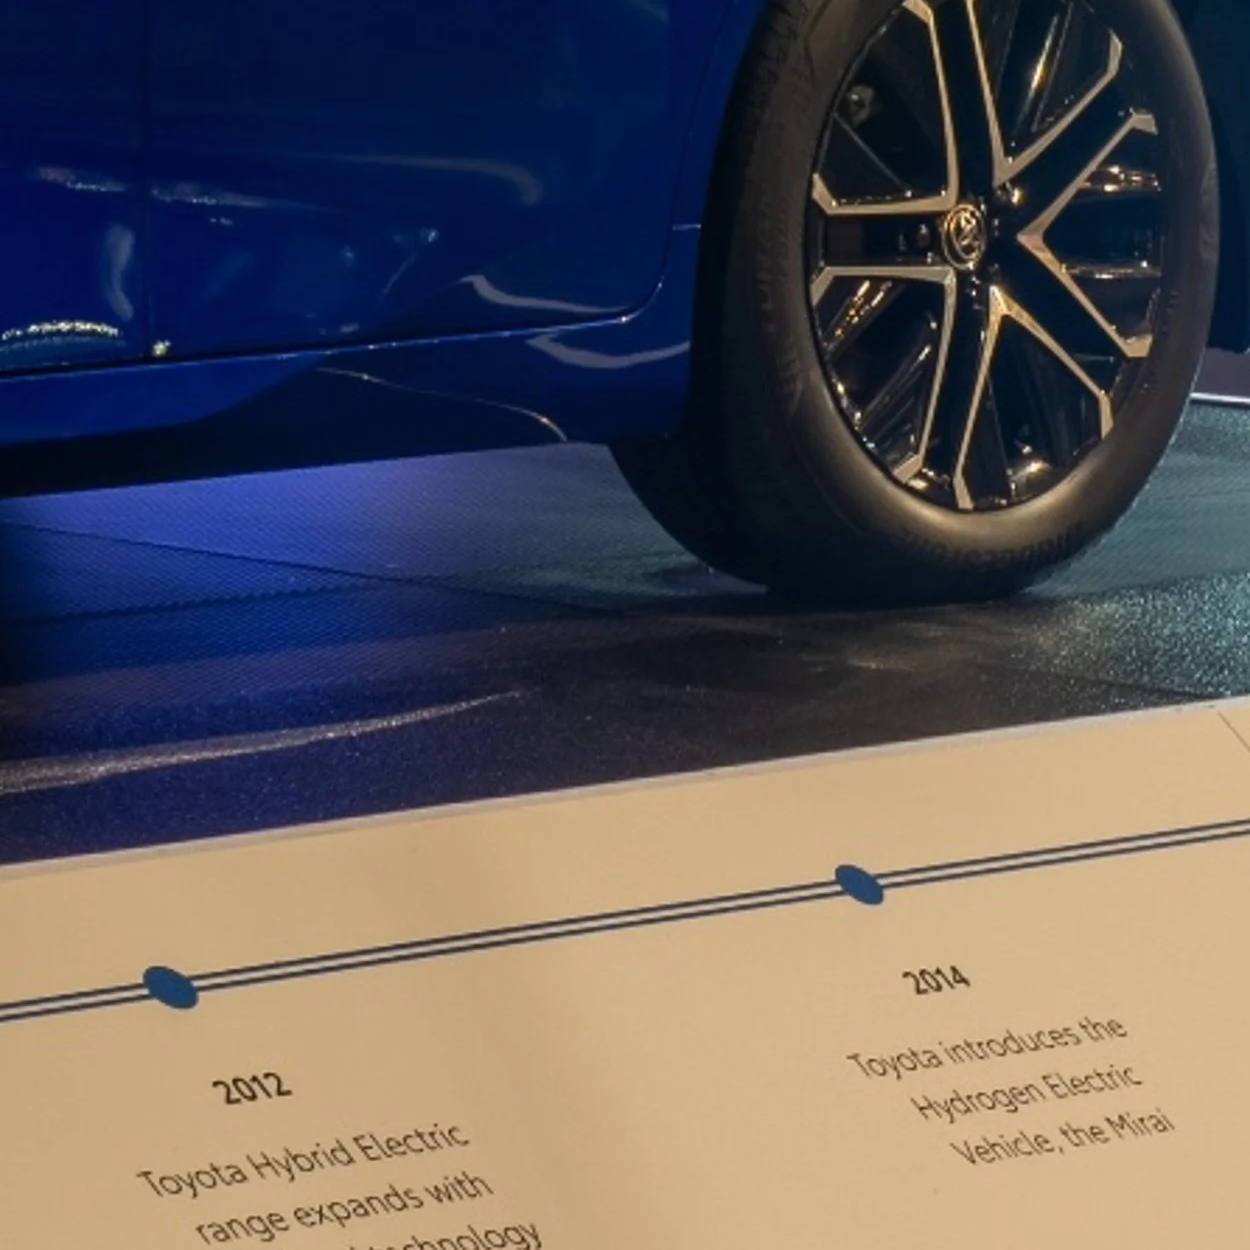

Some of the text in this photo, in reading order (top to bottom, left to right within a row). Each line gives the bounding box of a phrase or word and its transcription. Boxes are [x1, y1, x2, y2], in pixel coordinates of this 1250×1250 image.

[902, 965, 971, 995] 2014
[847, 1015, 1128, 1082] Toyota introduces the
[212, 1072, 293, 1104] 2012
[911, 1063, 1143, 1124] Hydrogen Electric
[136, 1122, 471, 1200] Toyota Hybrid Electric
[950, 1106, 1176, 1166] Vehicle, the Mirai
[195, 1170, 495, 1246] range expands with
